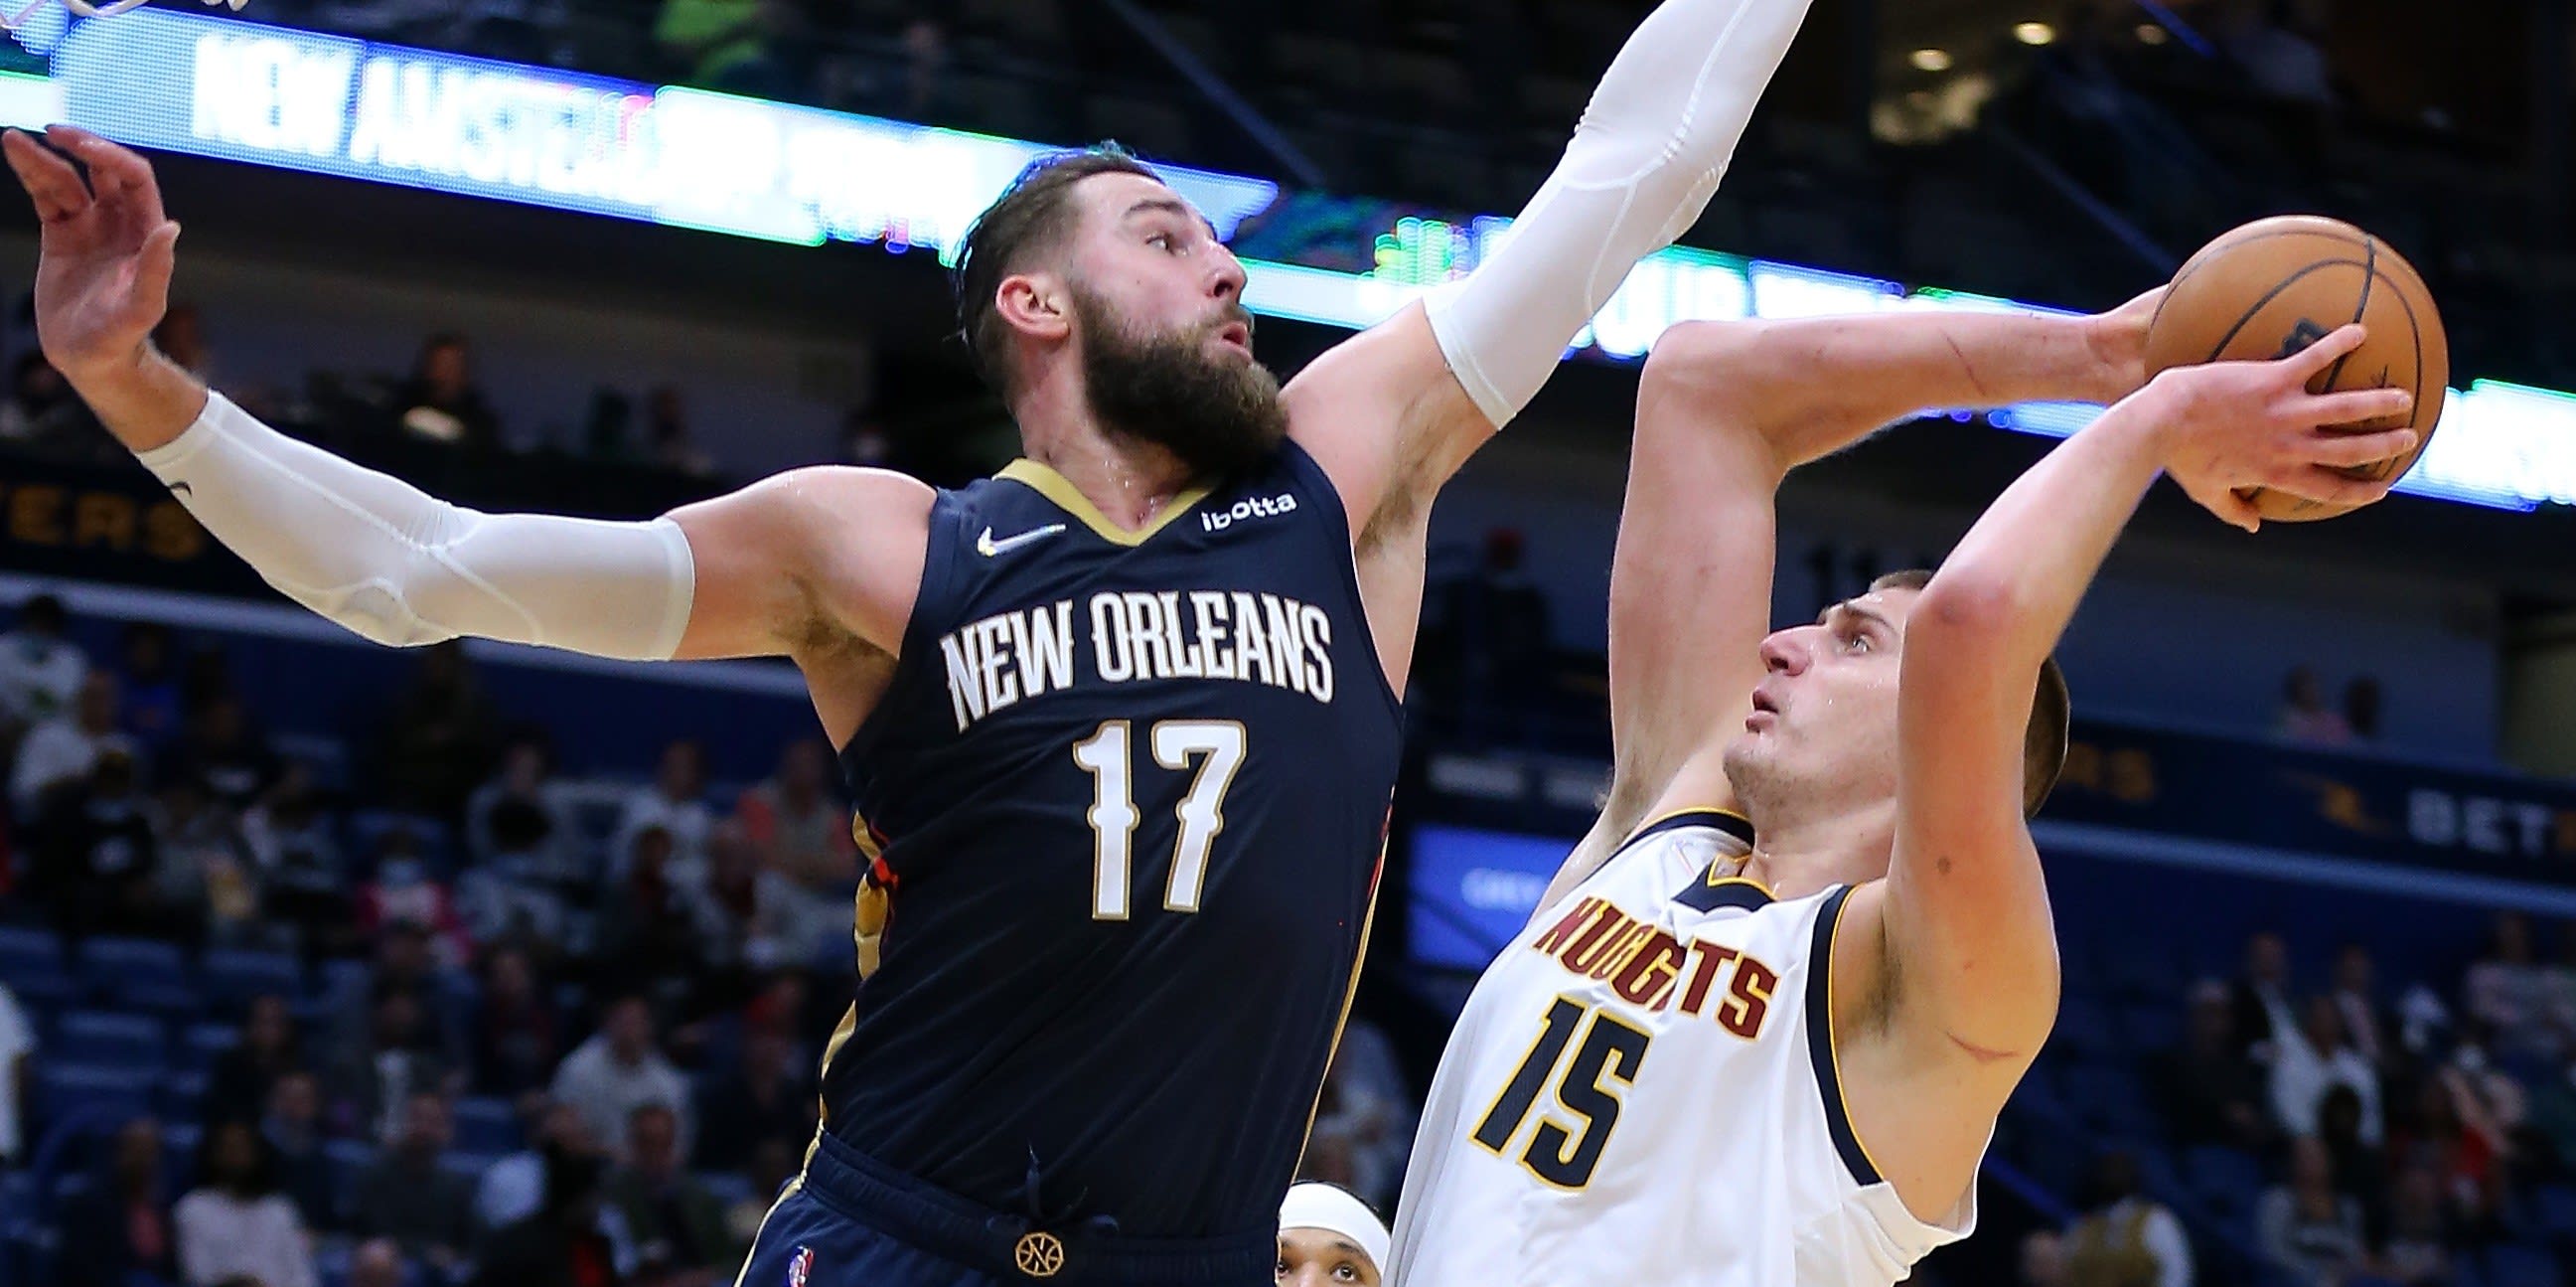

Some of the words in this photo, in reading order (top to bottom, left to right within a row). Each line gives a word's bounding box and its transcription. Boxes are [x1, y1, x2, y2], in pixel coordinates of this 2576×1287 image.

[1201, 493, 1297, 532] ibotta
[940, 599, 1074, 733] NEW
[1090, 591, 1334, 704] ORLEANS
[1073, 720, 1247, 920] 17
[1531, 895, 1781, 1042] NUGGTS
[1469, 992, 1652, 1193] 15
